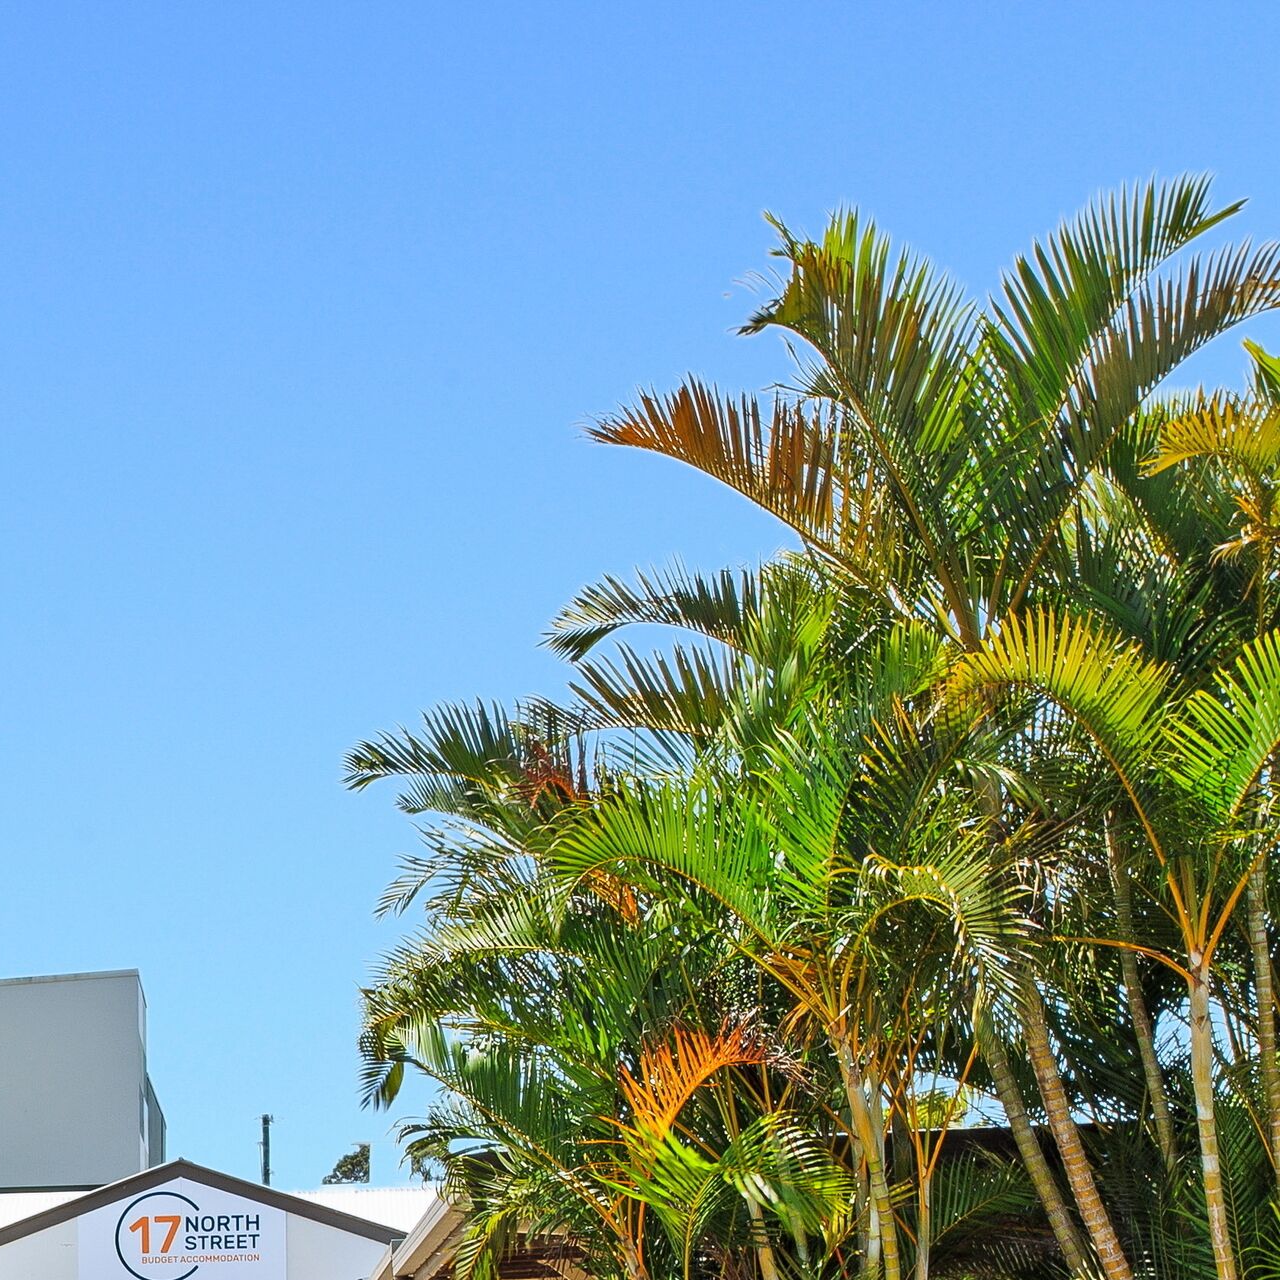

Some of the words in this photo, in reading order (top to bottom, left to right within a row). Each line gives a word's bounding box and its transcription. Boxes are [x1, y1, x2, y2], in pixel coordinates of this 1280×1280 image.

[185, 1214, 260, 1233] NORTH
[129, 1215, 182, 1254] 17
[184, 1233, 260, 1251] STREET
[141, 1255, 179, 1265] BUDGET
[180, 1253, 260, 1264] ACCOMMODATION
